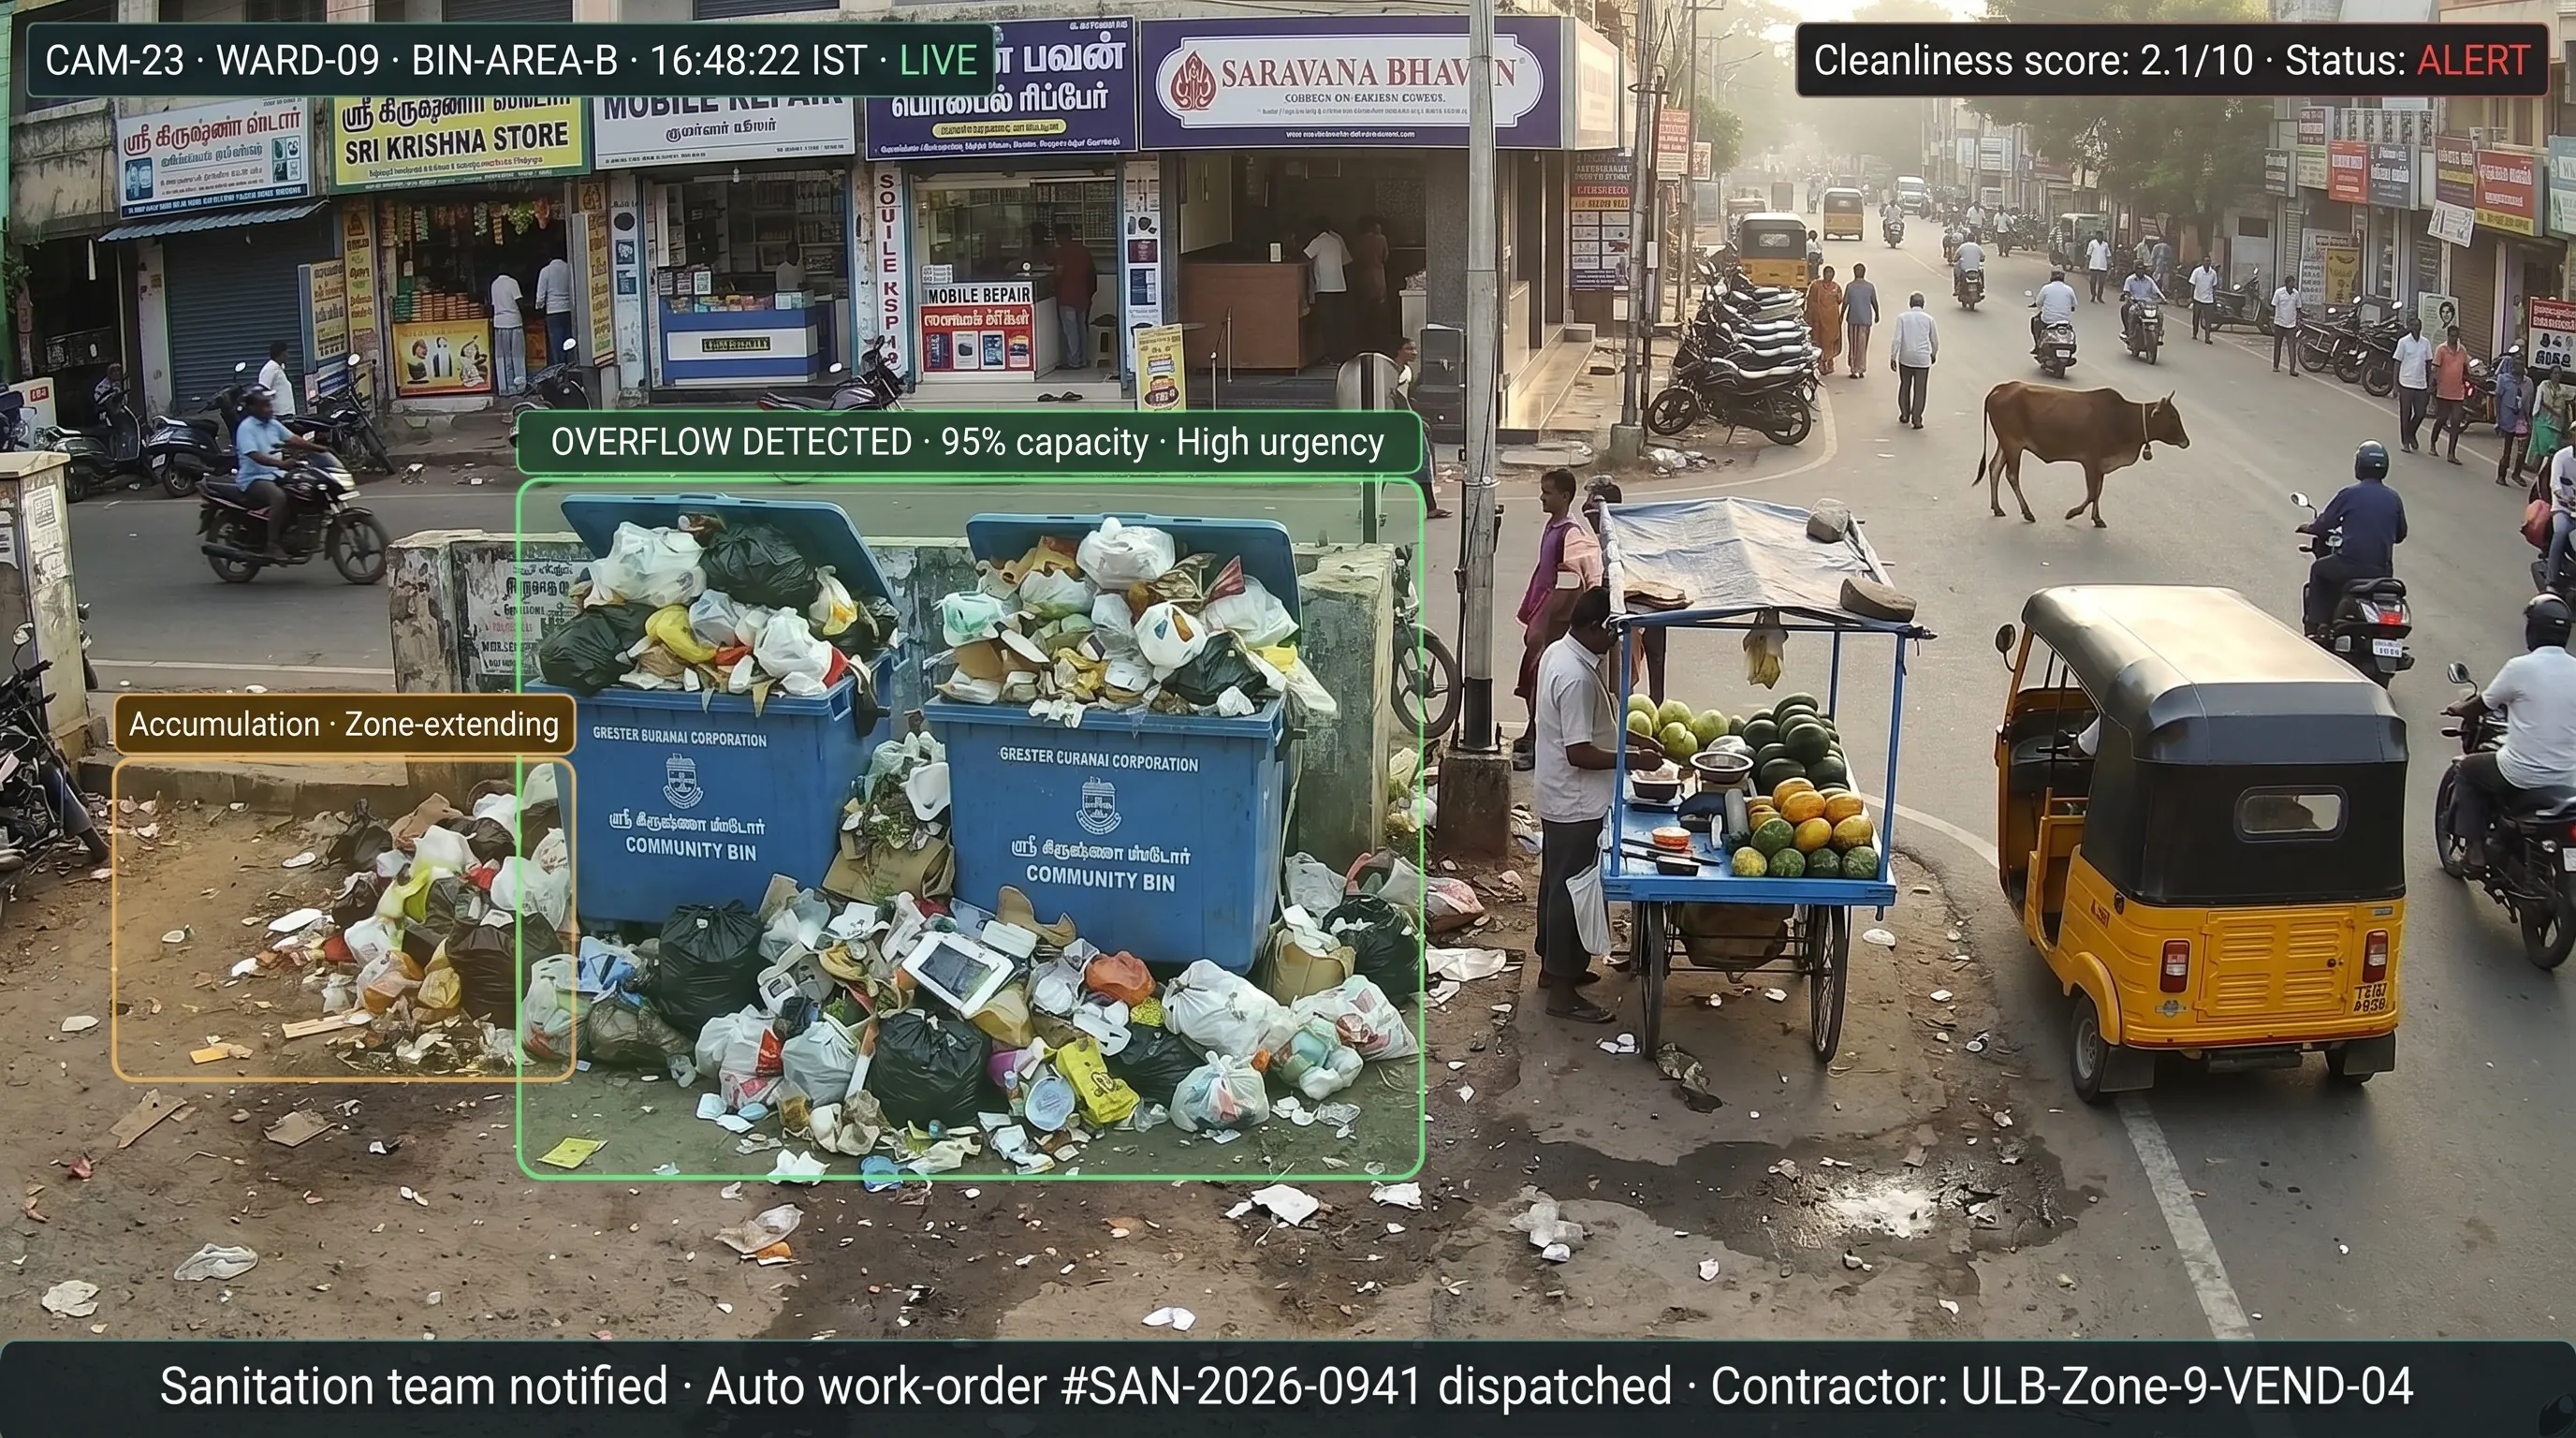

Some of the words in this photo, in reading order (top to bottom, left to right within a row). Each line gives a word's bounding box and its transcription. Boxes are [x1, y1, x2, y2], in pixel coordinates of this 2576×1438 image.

[1023, 31, 1126, 73] பவன்
[1222, 57, 1379, 88] SARAVANA
[1386, 57, 1516, 87] BHAVN
[1019, 81, 1109, 111] ரிப்பேர்
[345, 139, 379, 165] SRI
[387, 128, 487, 161] KRISHNA
[493, 121, 569, 153] STORE
[928, 287, 979, 304] MOBILE
[593, 726, 639, 741] GRESTER
[690, 731, 768, 748] CORPORATION
[999, 746, 1054, 764] GRESTER
[1112, 755, 1199, 772] CORPORATION
[625, 836, 723, 859] COMMUNITY
[727, 844, 757, 861] BIN
[1026, 864, 1138, 889] COMMUNITY
[1143, 873, 1176, 892] BIN
